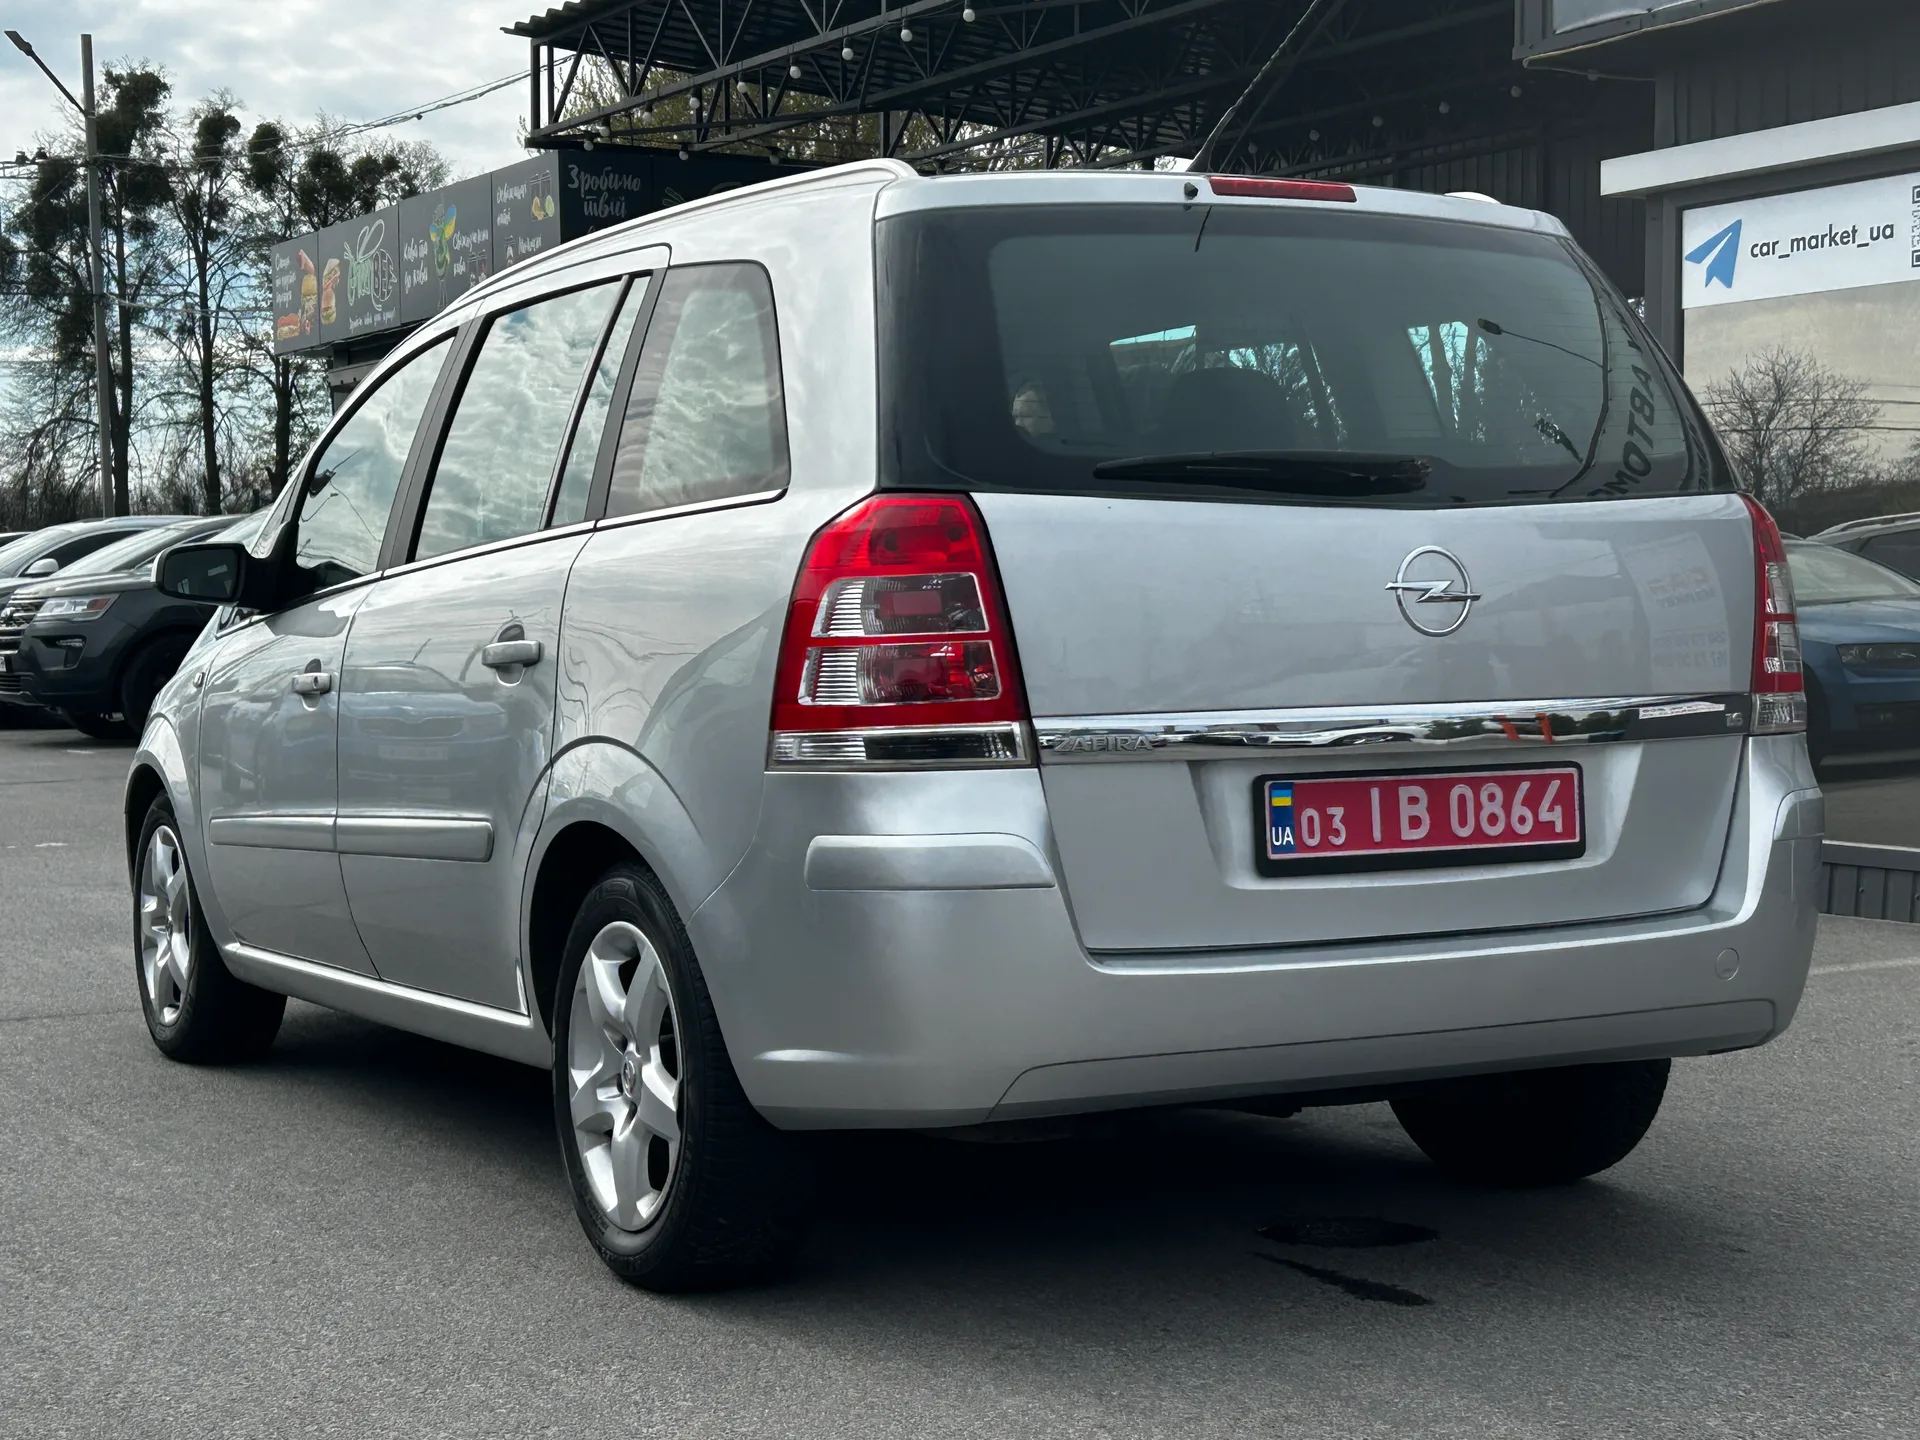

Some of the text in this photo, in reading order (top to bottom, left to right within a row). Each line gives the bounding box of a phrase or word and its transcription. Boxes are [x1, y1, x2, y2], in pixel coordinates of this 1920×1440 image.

[567, 164, 641, 198] Зробимо
[583, 192, 627, 218] твій
[1750, 223, 1894, 259] car_market_ua
[1054, 735, 1154, 752] ZAFIRA
[1272, 780, 1562, 847] UA 03 IB 0864
